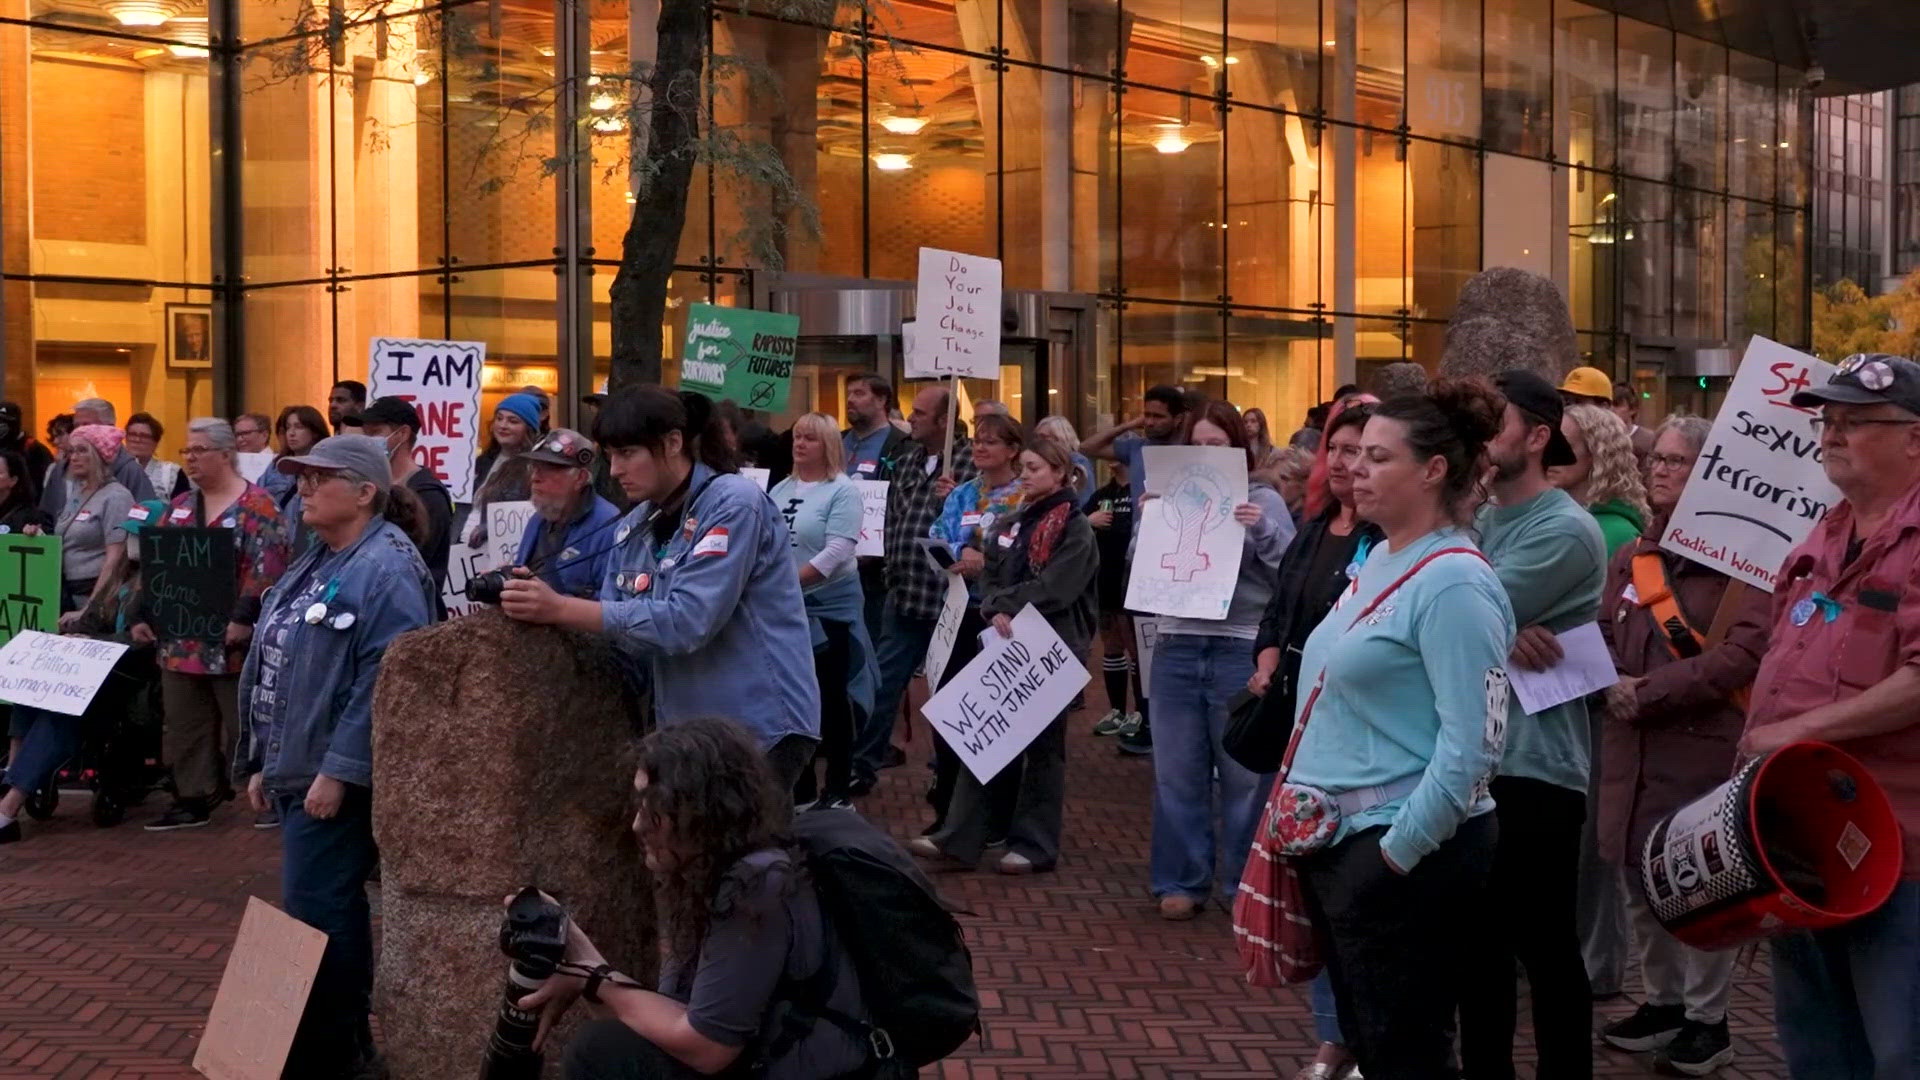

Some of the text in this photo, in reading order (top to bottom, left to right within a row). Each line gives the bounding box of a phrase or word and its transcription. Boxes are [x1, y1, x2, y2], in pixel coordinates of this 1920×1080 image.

[1426, 76, 1465, 128] 915
[950, 256, 967, 274] Do
[945, 275, 981, 294] Your
[945, 295, 974, 315] Job
[688, 318, 732, 344] justice
[940, 315, 984, 340] Change
[697, 341, 721, 360] for
[942, 337, 972, 354] The
[386, 351, 474, 389] I AM
[491, 371, 556, 384] AUDITORIUM
[681, 359, 727, 385] SURVIVORS
[747, 355, 792, 379] FUTURES
[935, 355, 973, 374] Laws
[1761, 362, 1812, 395] St
[399, 395, 465, 438] ANE
[1732, 411, 1823, 464] Sexu
[411, 446, 450, 480] OE
[147, 535, 212, 569] I AM
[1668, 528, 1777, 584] Radical Wome
[8, 545, 45, 606] I
[150, 571, 200, 617] Jane
[942, 640, 1031, 736] WE STAND
[963, 641, 1068, 756] WITH JANE DOE
